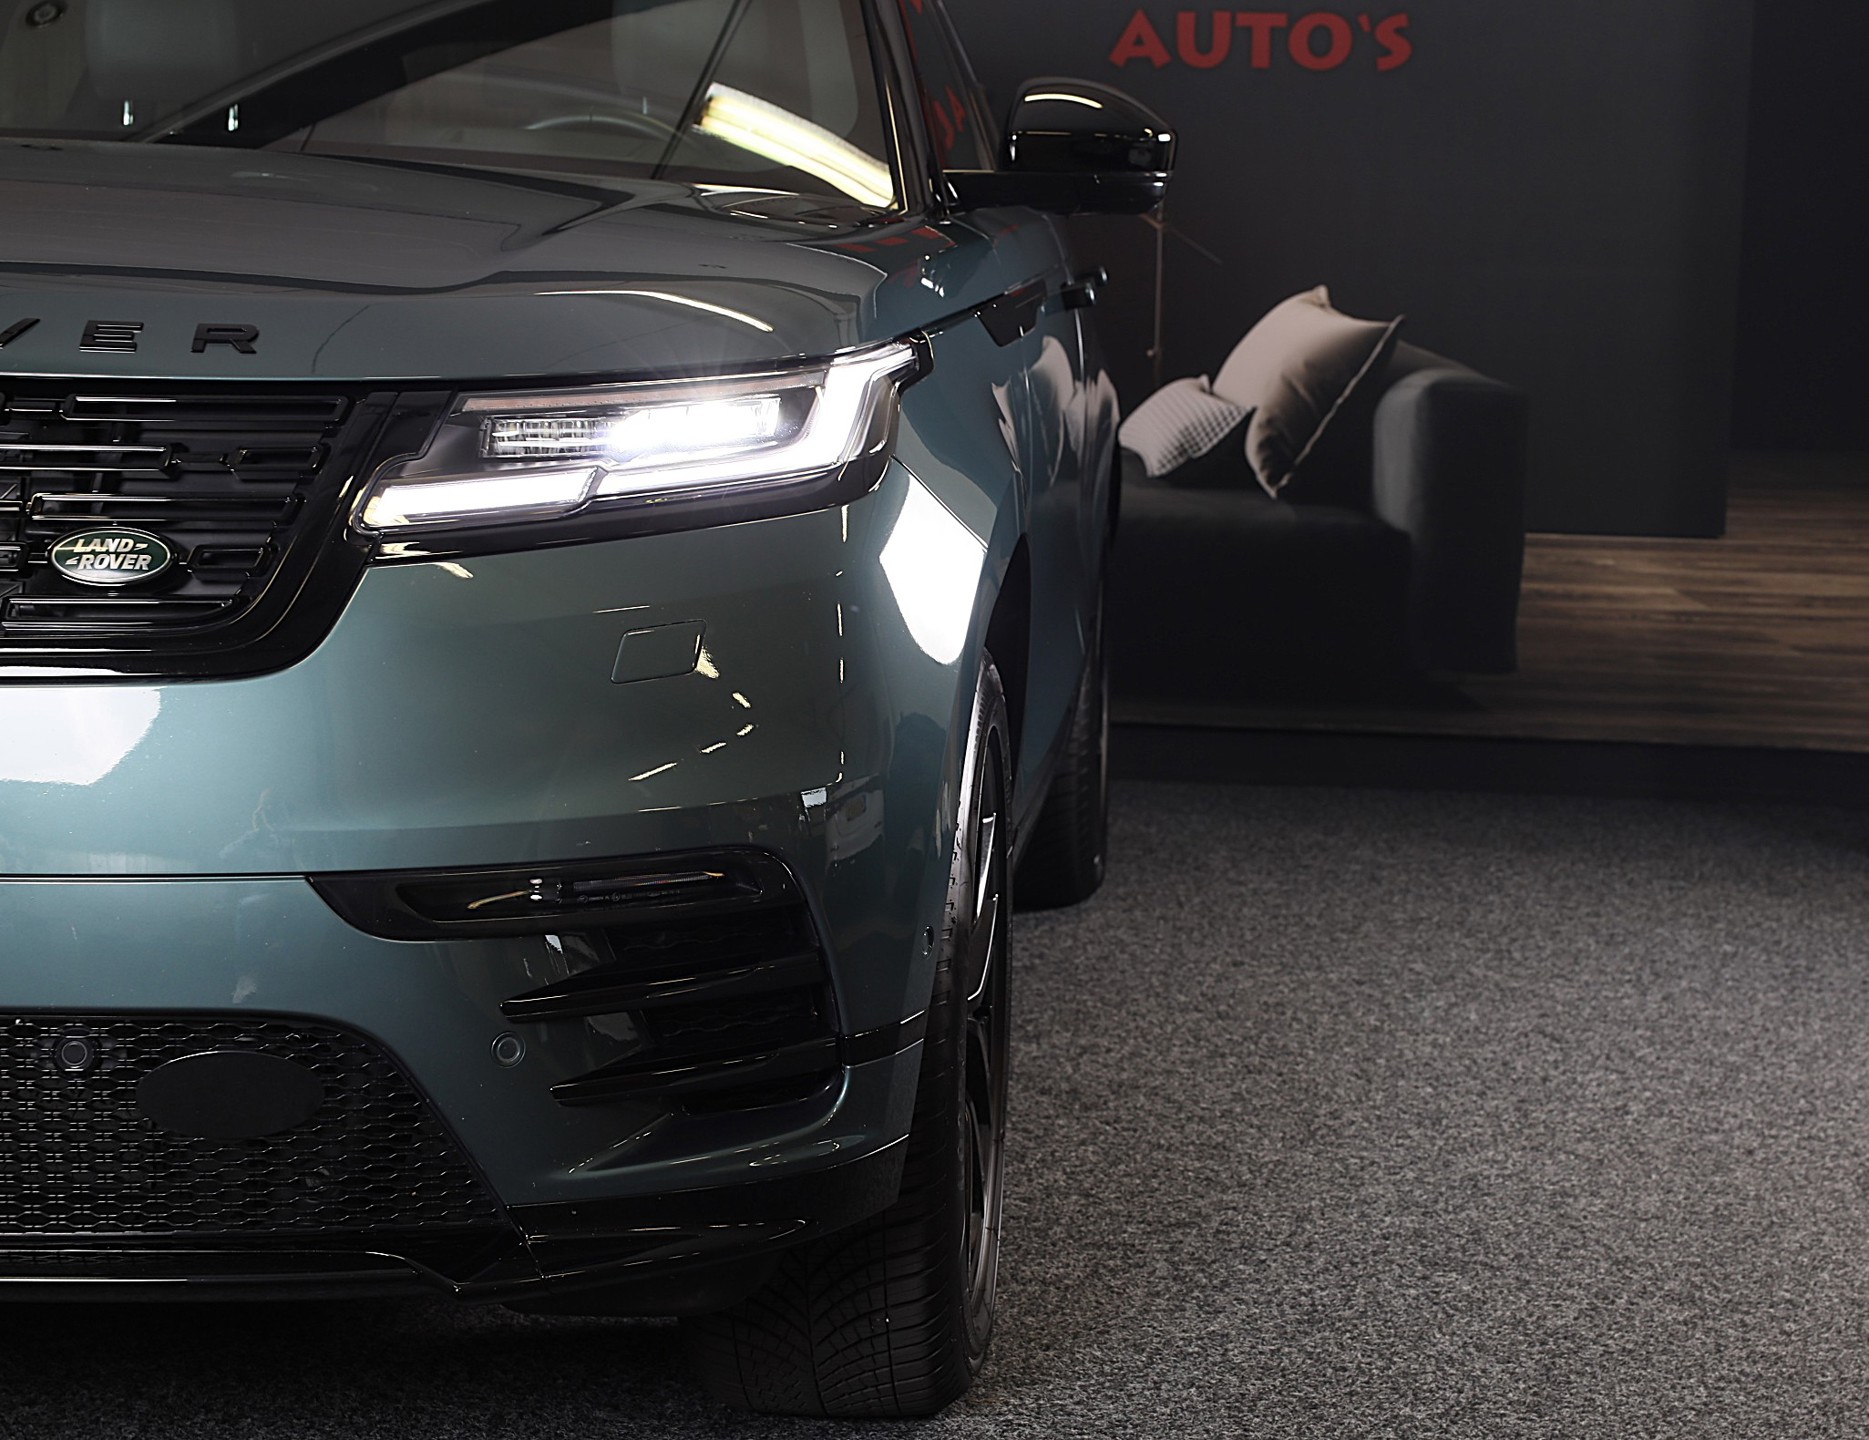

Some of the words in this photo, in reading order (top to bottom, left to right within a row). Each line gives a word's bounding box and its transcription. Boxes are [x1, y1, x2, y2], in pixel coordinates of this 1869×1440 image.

[1109, 8, 1413, 72] AUTO'S
[73, 538, 134, 553] LAND
[77, 554, 152, 570] ROVER
